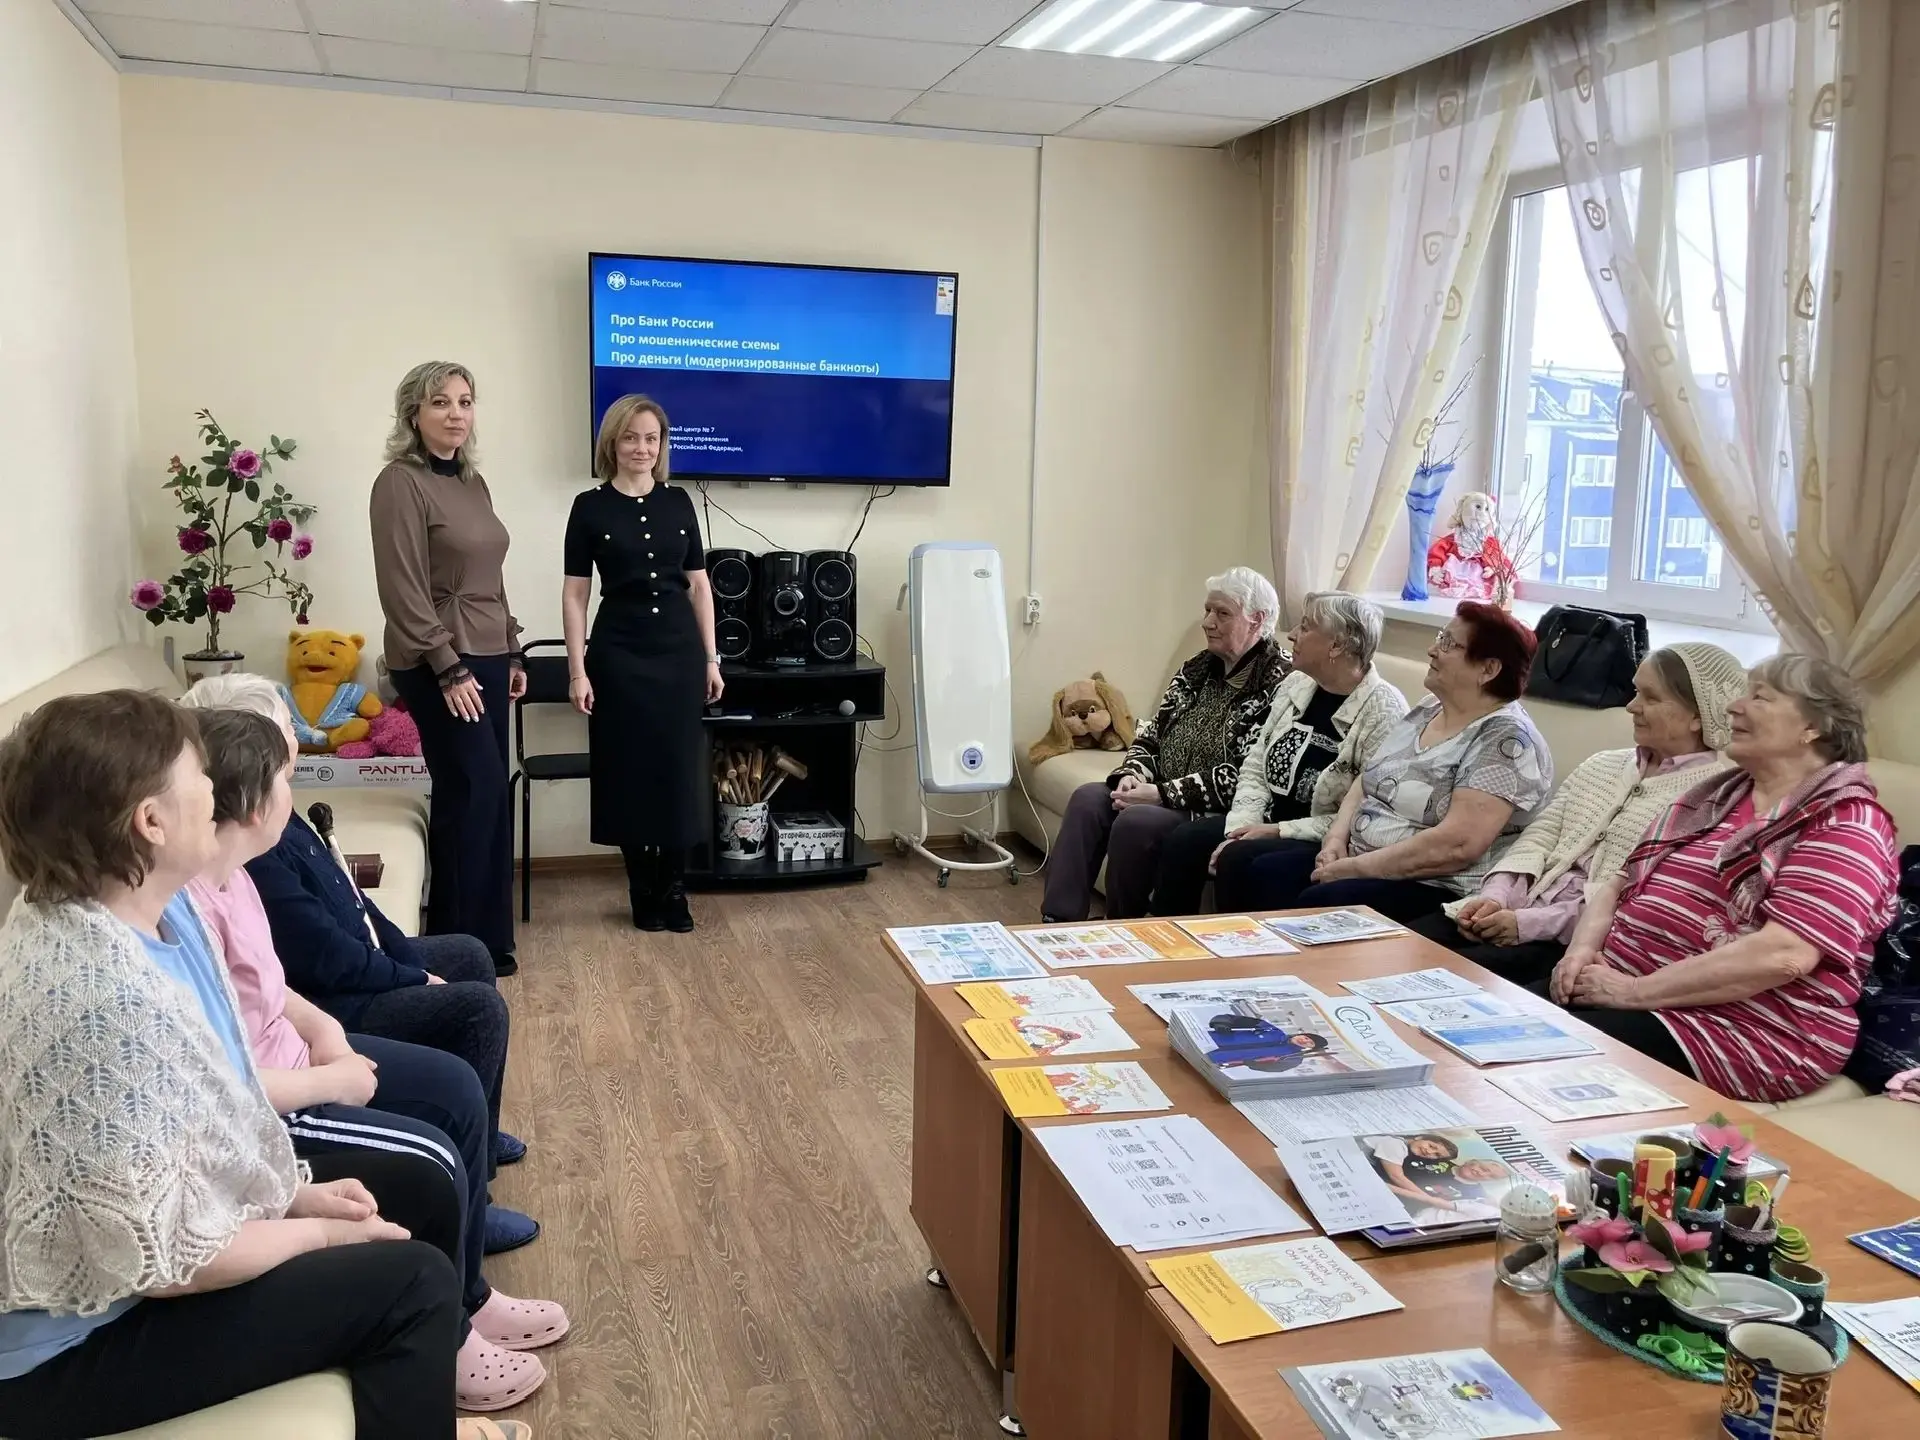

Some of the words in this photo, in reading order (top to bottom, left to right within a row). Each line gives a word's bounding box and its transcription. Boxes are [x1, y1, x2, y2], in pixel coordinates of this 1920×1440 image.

[629, 278, 651, 287] Банк
[652, 278, 682, 289] России
[611, 314, 635, 327] Про
[638, 315, 668, 328] Банк
[671, 317, 714, 329] России
[611, 333, 635, 346] Про
[638, 335, 739, 349] мошеннические
[741, 340, 780, 351] схемы
[611, 351, 635, 364] Про
[639, 354, 681, 366] деньги
[685, 353, 816, 371] (модернизированные
[819, 359, 880, 375] банкноты)
[673, 443, 707, 451] Российской
[359, 765, 427, 775] PANTU
[1285, 1248, 1301, 1261] ОН
[1296, 1260, 1330, 1286] НУЖЕН
[1298, 1246, 1308, 1254] И
[1304, 1254, 1332, 1276] ЗАЧЕМ
[1312, 1243, 1328, 1259] ЧТО
[1327, 1259, 1354, 1281] ТАКОЕ
[1350, 1281, 1372, 1295] КПК
